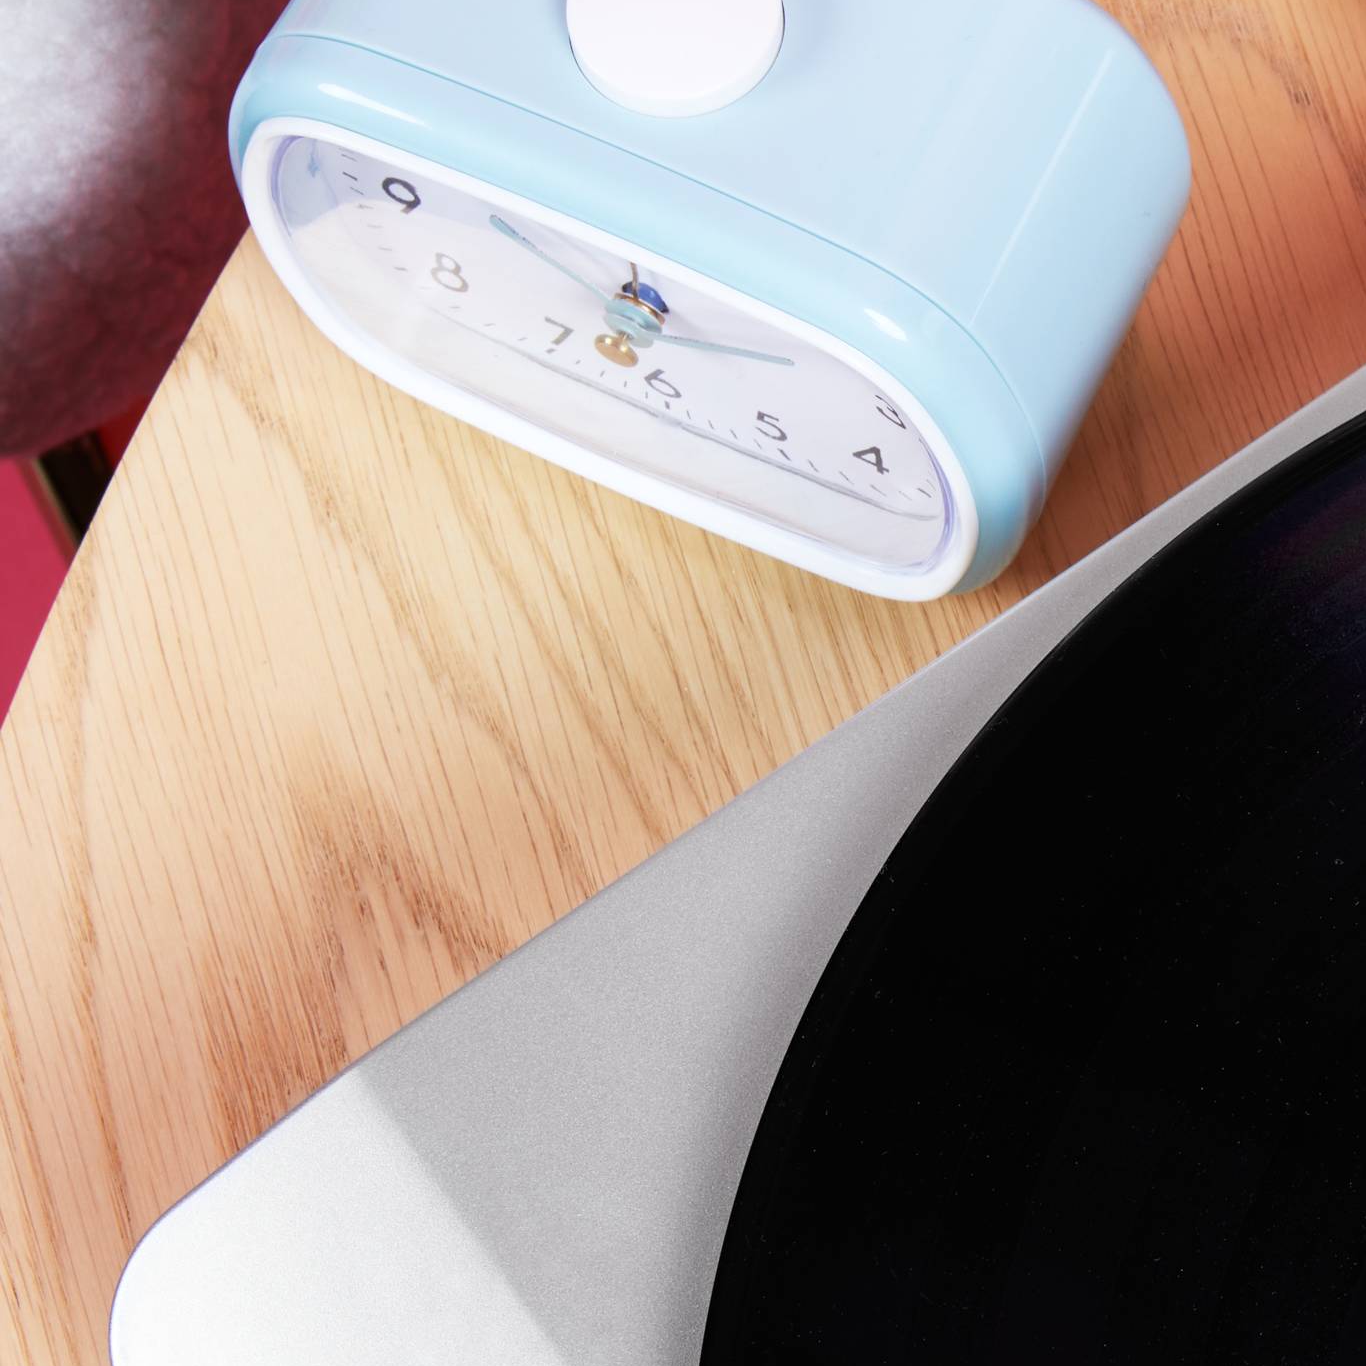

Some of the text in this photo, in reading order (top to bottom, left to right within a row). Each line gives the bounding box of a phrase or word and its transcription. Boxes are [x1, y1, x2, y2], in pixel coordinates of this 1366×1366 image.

[381, 176, 421, 214] 9
[430, 252, 470, 294] 8
[544, 316, 575, 346] 7
[643, 368, 683, 400] 6
[756, 410, 788, 442] 5
[852, 446, 890, 475] 4
